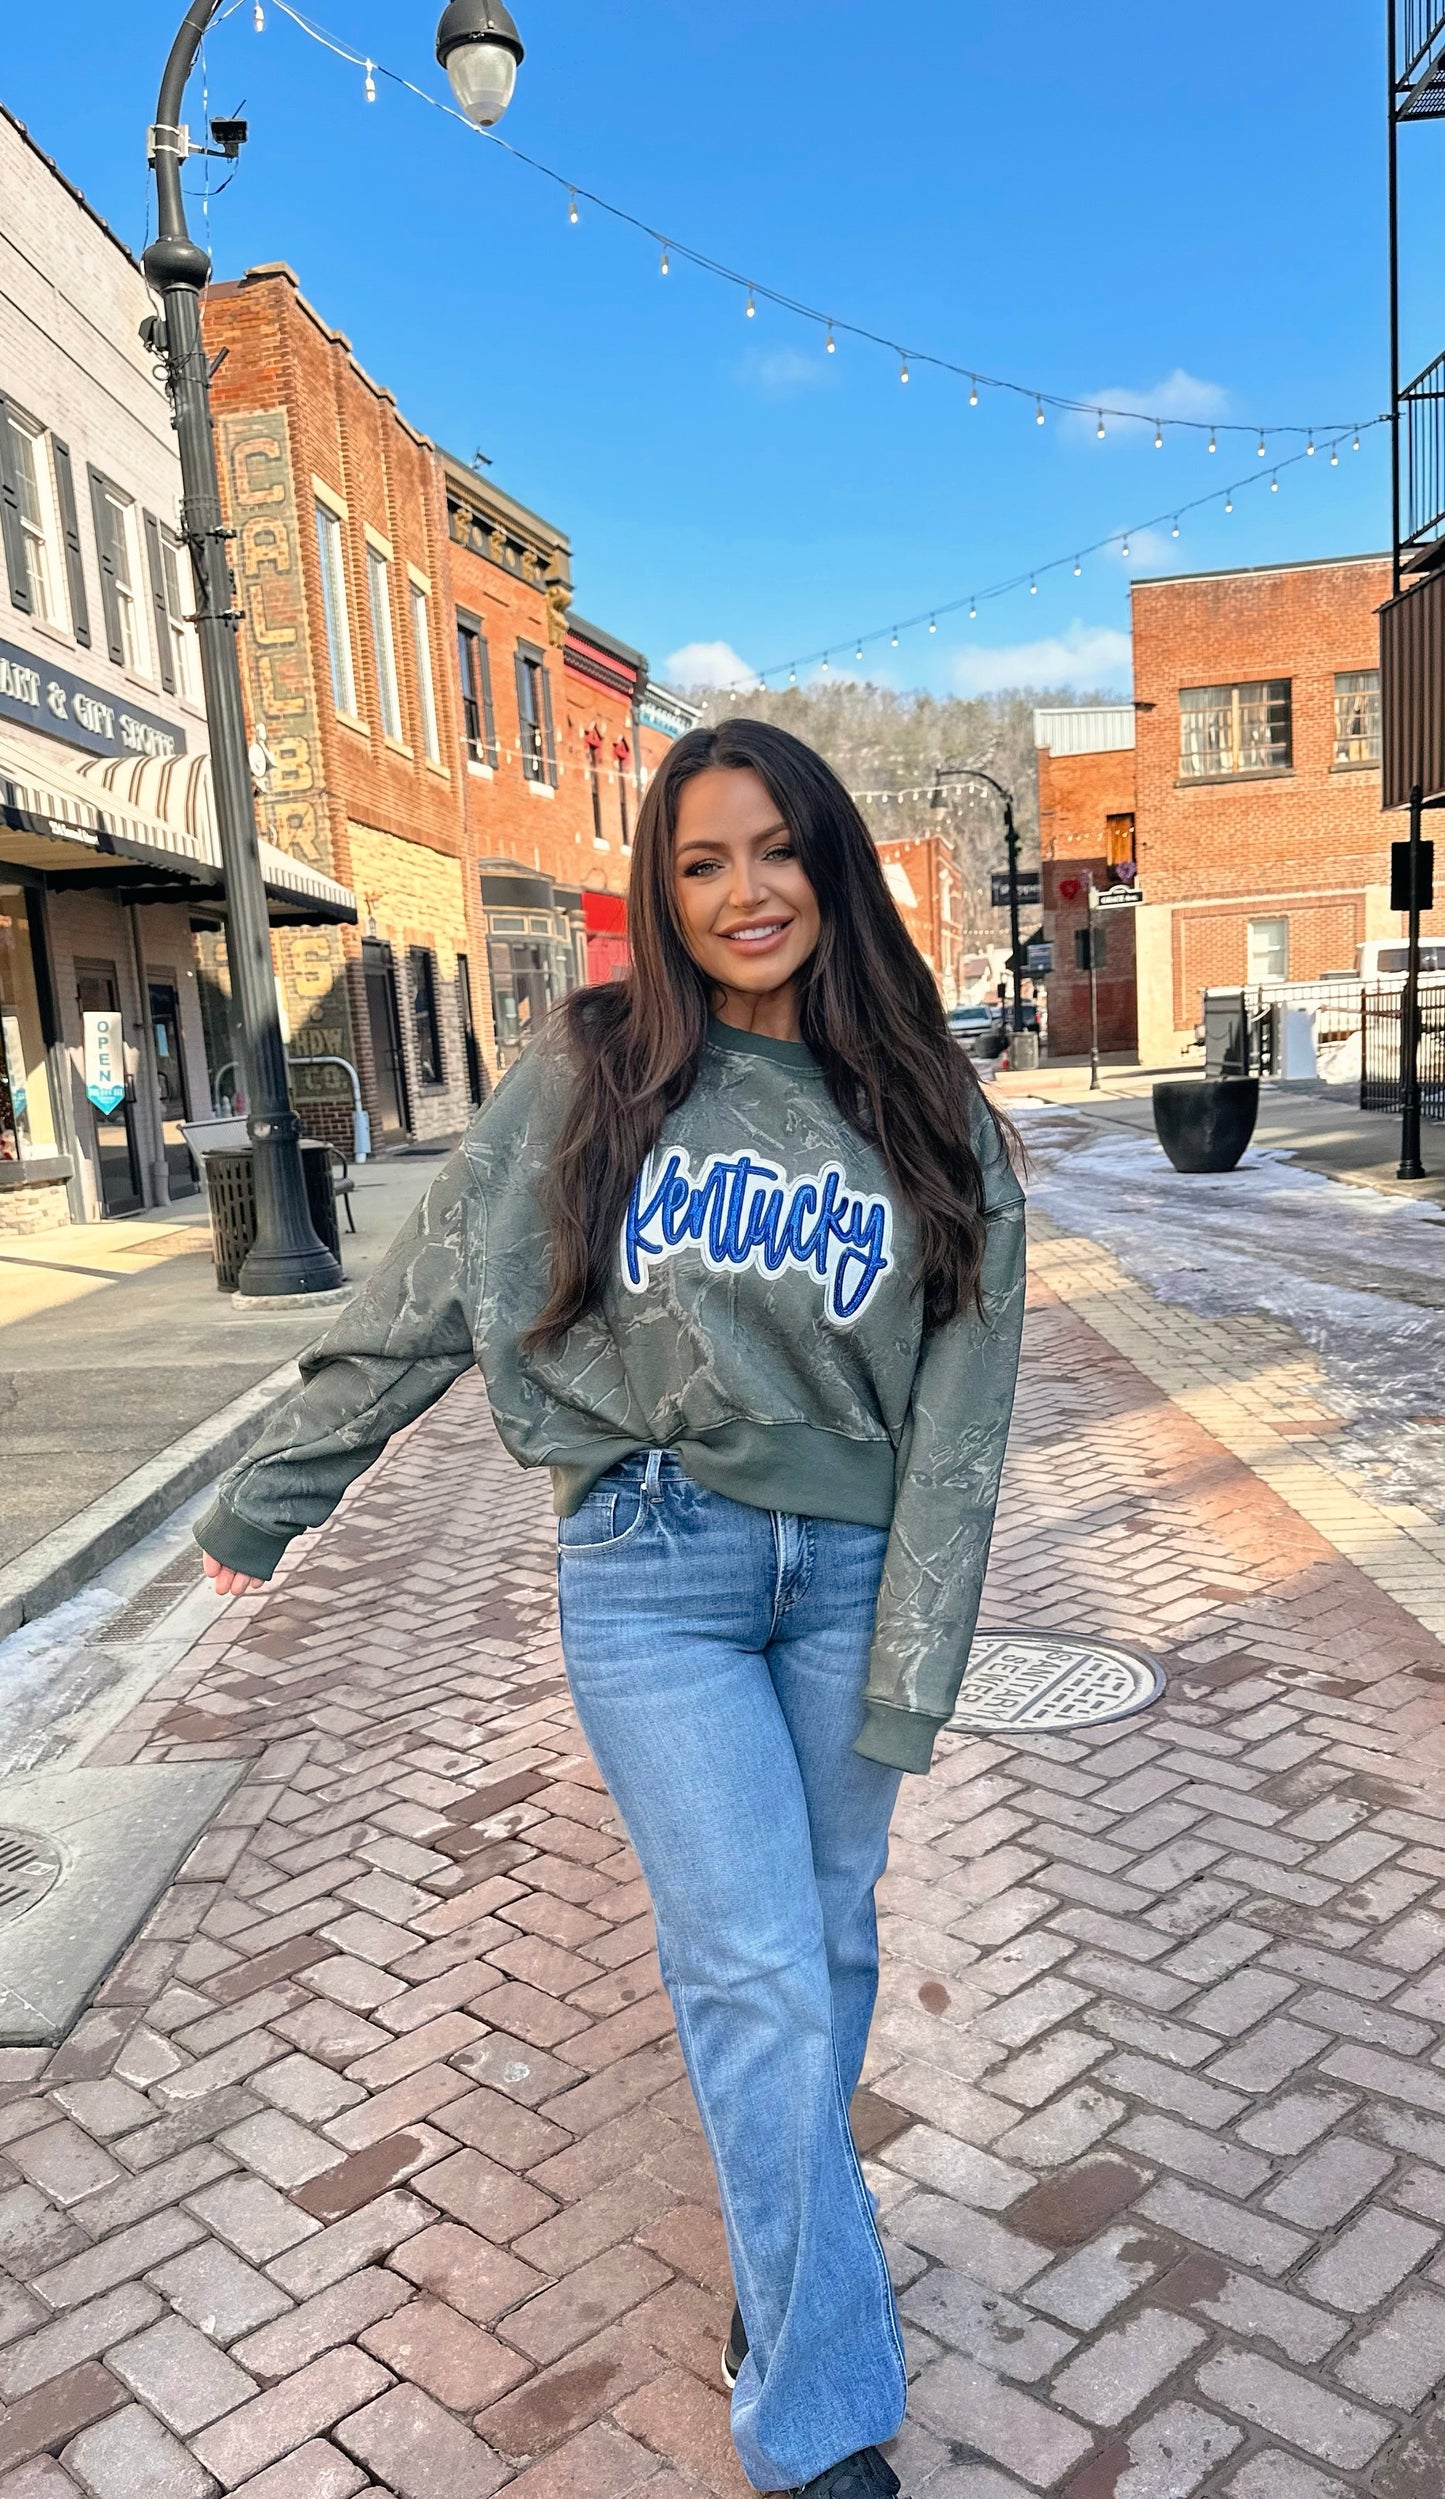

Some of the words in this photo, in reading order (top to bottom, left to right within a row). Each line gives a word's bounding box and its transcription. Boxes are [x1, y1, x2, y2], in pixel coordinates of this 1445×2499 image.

[47, 681, 69, 720] &
[72, 692, 116, 739] GIFT
[97, 1020, 112, 1082] OPEN
[622, 1150, 890, 1322] Kentucky
[959, 1654, 1028, 1703] SEWER
[976, 1651, 1073, 1718] SANITARY
